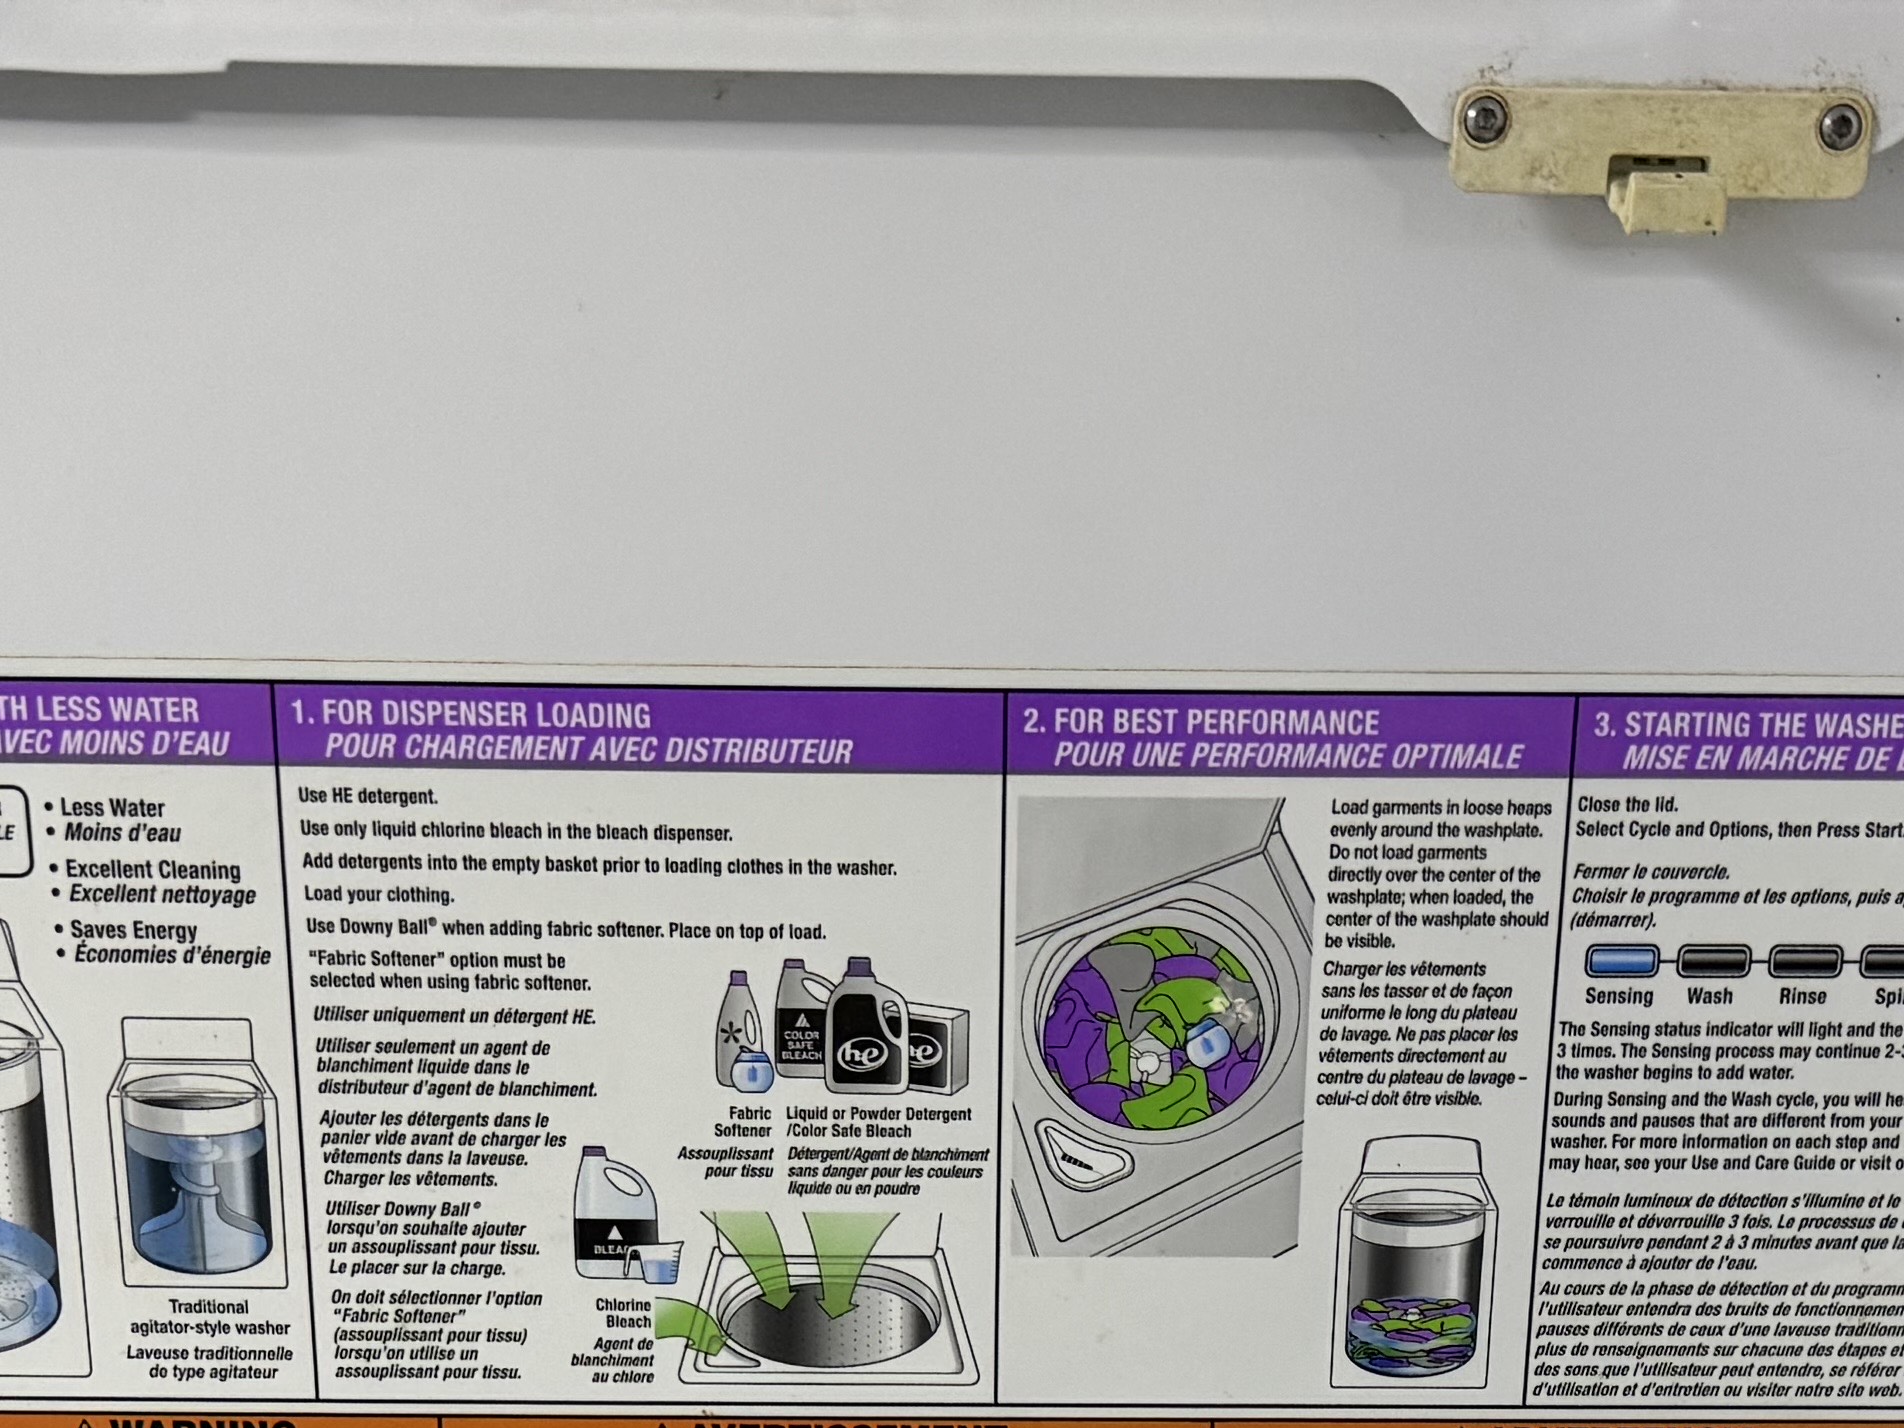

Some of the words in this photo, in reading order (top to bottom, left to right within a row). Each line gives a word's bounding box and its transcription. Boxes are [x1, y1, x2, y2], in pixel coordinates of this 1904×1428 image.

[37, 696, 101, 721] LESS
[108, 697, 198, 722] WATER
[292, 700, 314, 724] 1.
[323, 699, 372, 724] FOR
[383, 700, 526, 726] DISPENSER
[538, 702, 650, 728] LOADING
[1024, 708, 1045, 732] 2.
[1056, 708, 1103, 733] FOR
[1114, 709, 1178, 734] BEST
[1188, 709, 1379, 735] PERFORMANCE
[1595, 712, 1616, 736] 3.
[1625, 712, 1750, 737] STARTING
[1760, 712, 1807, 737] THE
[60, 730, 144, 754] MOINS
[152, 731, 230, 756] D'EAU
[326, 733, 396, 758] POUR
[405, 734, 585, 760] CHARGEMENT
[589, 736, 658, 761] AVEC
[665, 738, 853, 764] DISTRIBUTEUR
[1055, 742, 1125, 766] POUR
[1133, 742, 1186, 766] UNE
[1191, 742, 1387, 768] PERFORMANCE
[1392, 743, 1525, 768] OPTIMALE
[1623, 745, 1691, 769] MISE
[1695, 745, 1732, 770] EN
[1737, 746, 1850, 770] MARCHE
[1855, 747, 1893, 770] DE
[61, 797, 104, 816] Less
[109, 798, 165, 817] Water
[298, 787, 327, 803] Use
[332, 787, 352, 803] HE
[358, 788, 438, 808] detergent.
[1578, 796, 1620, 812] Close
[1626, 796, 1650, 812] the
[1656, 796, 1678, 812] lid.
[65, 822, 122, 841] Moins
[128, 823, 181, 842] d'eau
[300, 820, 329, 836] Use
[334, 820, 366, 840] only
[372, 820, 416, 840] liquid
[422, 822, 484, 838] chlorine
[490, 822, 542, 838] bleach
[548, 822, 561, 839] in
[567, 824, 591, 839] the
[596, 824, 648, 840] bleach
[654, 824, 732, 844] dispenser.
[1576, 820, 1624, 836] Select
[1629, 820, 1670, 840] Cycle
[1676, 821, 1704, 836] and
[1710, 821, 1772, 840] Options,
[1778, 822, 1812, 837] then
[1818, 822, 1860, 838] Press
[66, 859, 152, 879] Excellent
[159, 860, 240, 884] Cleaning
[70, 883, 156, 903] Excellent
[162, 886, 256, 908] nettoyage
[71, 920, 126, 940] Saves
[133, 920, 197, 944] Energy
[74, 940, 179, 965] Économies
[183, 943, 272, 968] d'énergie
[1586, 987, 1653, 1008] Sensing
[1688, 987, 1732, 1004] Wash
[1780, 987, 1827, 1004] Rinse
[783, 1031, 820, 1040] COLOR
[730, 1106, 771, 1120] Fabric
[787, 1106, 827, 1122] Liquid
[832, 1109, 846, 1120] or
[851, 1106, 901, 1120] Powder
[906, 1107, 971, 1124] Detergent
[715, 1123, 772, 1137] Softener
[787, 1123, 827, 1137] /Color
[832, 1124, 861, 1137] Safe
[866, 1124, 911, 1138] Bleach
[168, 1299, 248, 1314] Traditional
[596, 1298, 651, 1311] Chlorine
[131, 1320, 230, 1337] agitator-style
[235, 1320, 290, 1335] washer
[607, 1315, 651, 1328] Bleach
